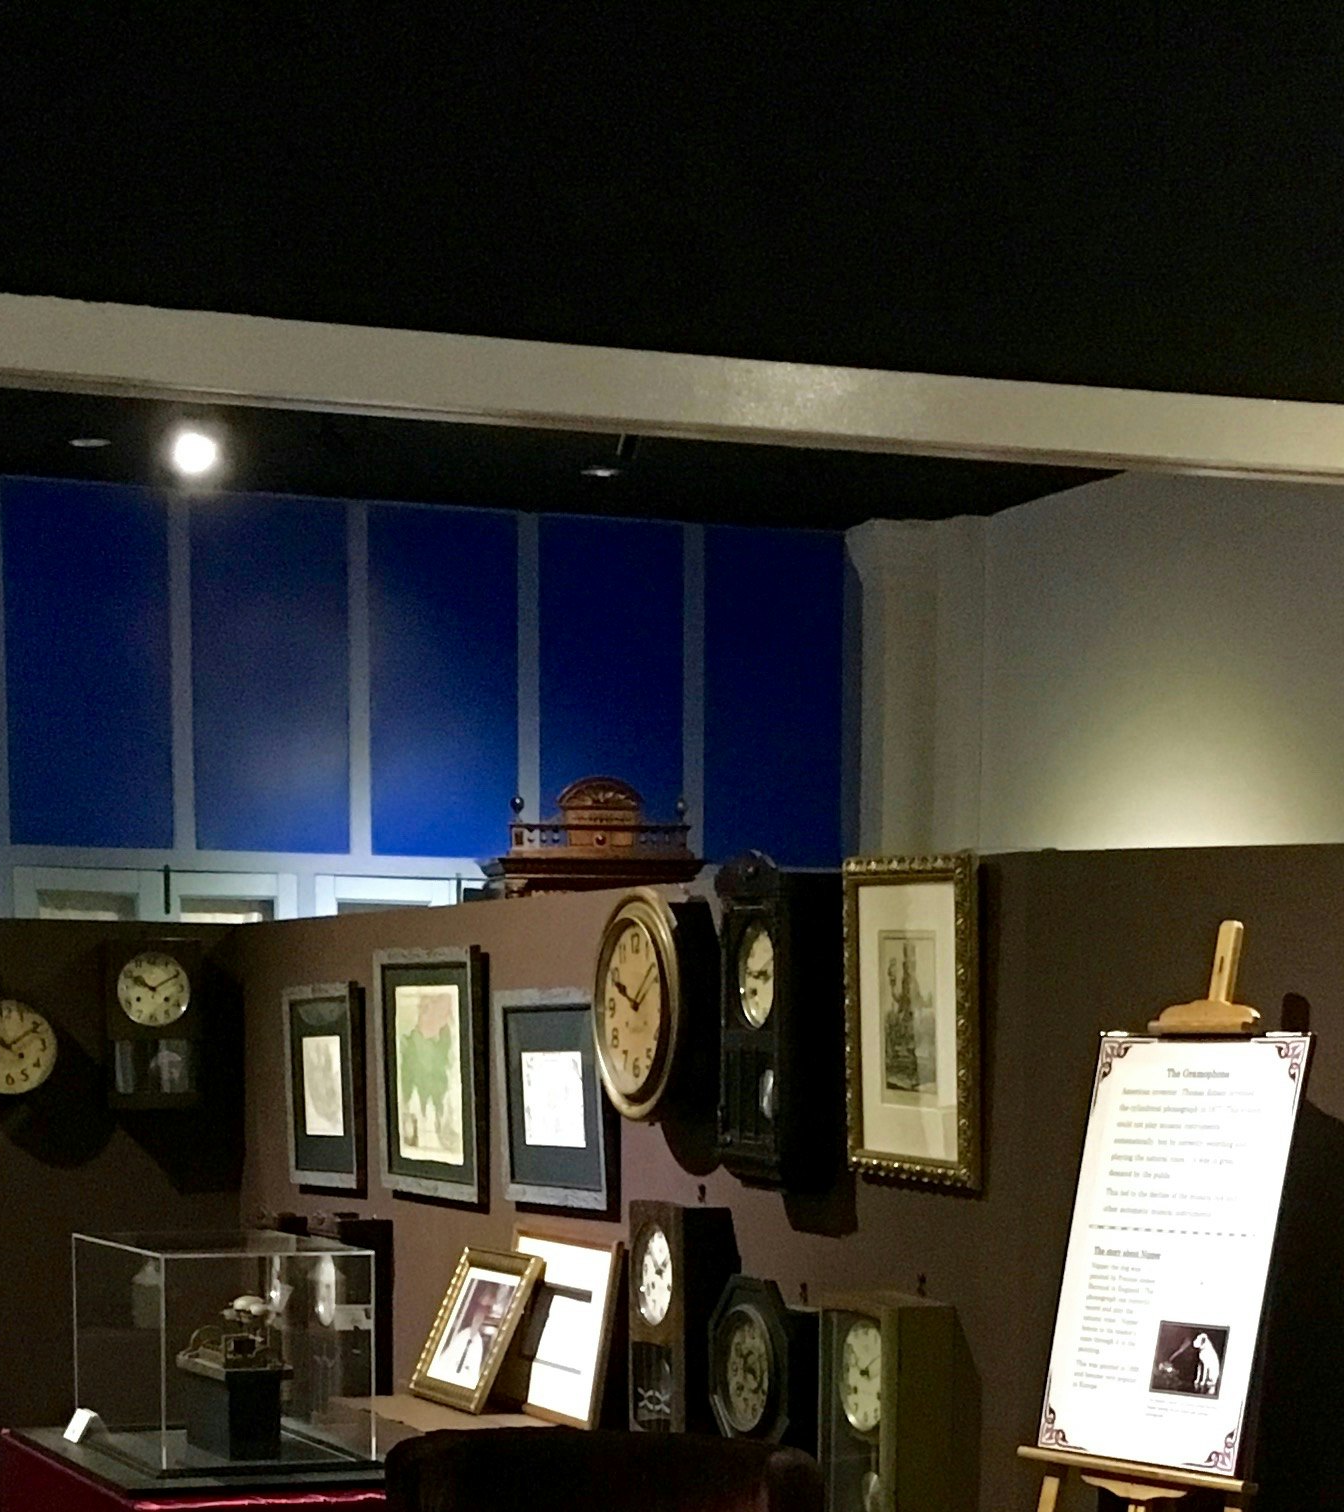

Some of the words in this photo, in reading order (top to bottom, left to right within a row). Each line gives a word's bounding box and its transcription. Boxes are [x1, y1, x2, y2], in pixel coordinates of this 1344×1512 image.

[631, 932, 640, 954] 12
[609, 998, 616, 1018] 9
[611, 1027, 619, 1048] 8
[622, 1050, 628, 1070] 7
[632, 1057, 640, 1078] 6
[5, 1074, 15, 1086] 6
[20, 1068, 29, 1081] 5
[1167, 1068, 1180, 1078] The
